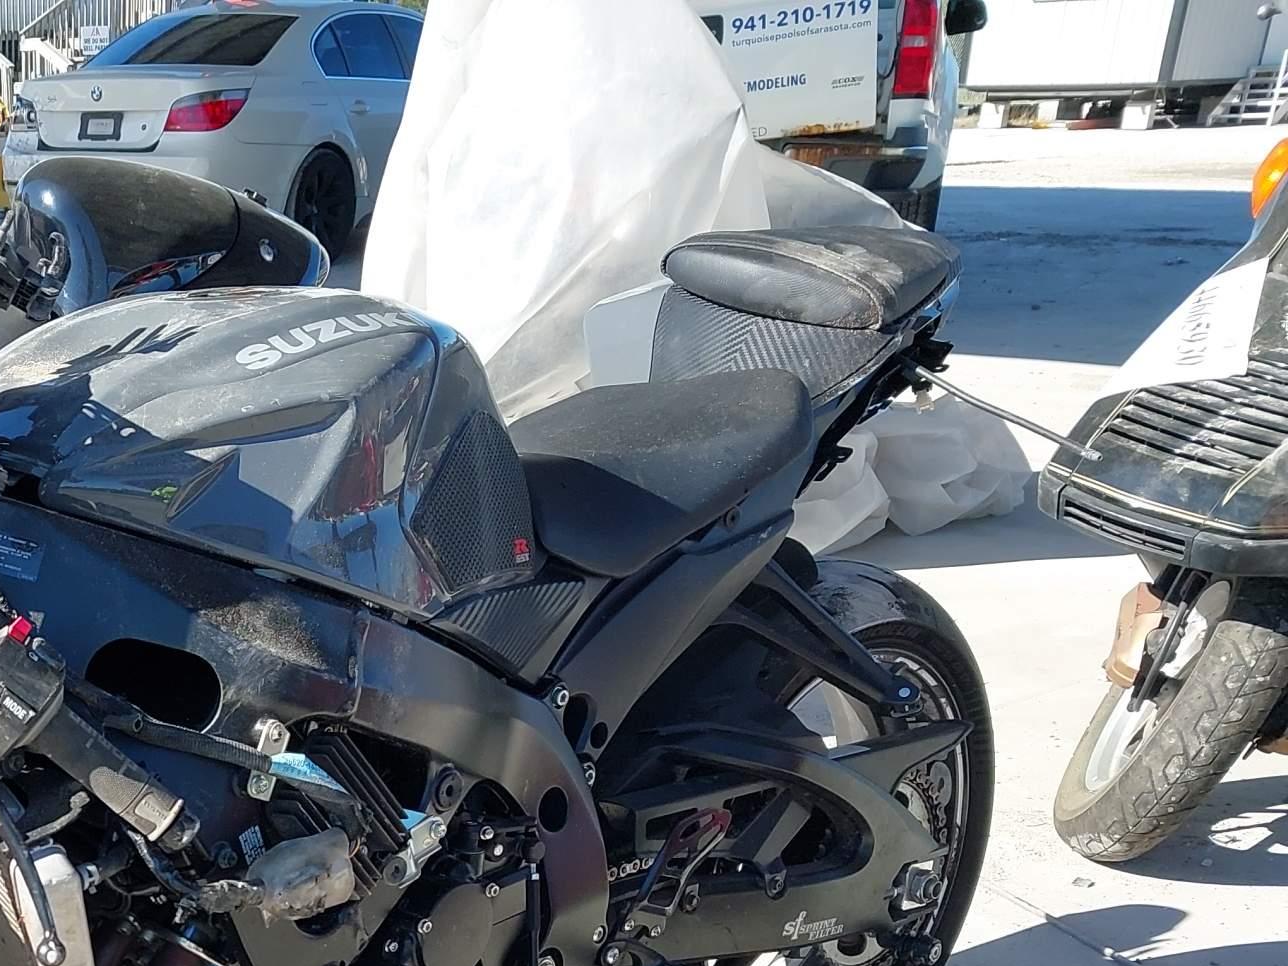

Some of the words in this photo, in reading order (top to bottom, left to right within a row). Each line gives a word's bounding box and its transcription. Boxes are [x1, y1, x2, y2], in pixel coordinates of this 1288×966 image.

[732, 0, 872, 34] 941-210-1719
[732, 19, 872, 47] turquoisepoolsofsarasota.com
[743, 73, 807, 92] MODELING
[235, 312, 431, 370] SUZUKI
[3, 696, 27, 720] MODE
[799, 918, 838, 934] SPRINT
[808, 924, 844, 941] FILTER
